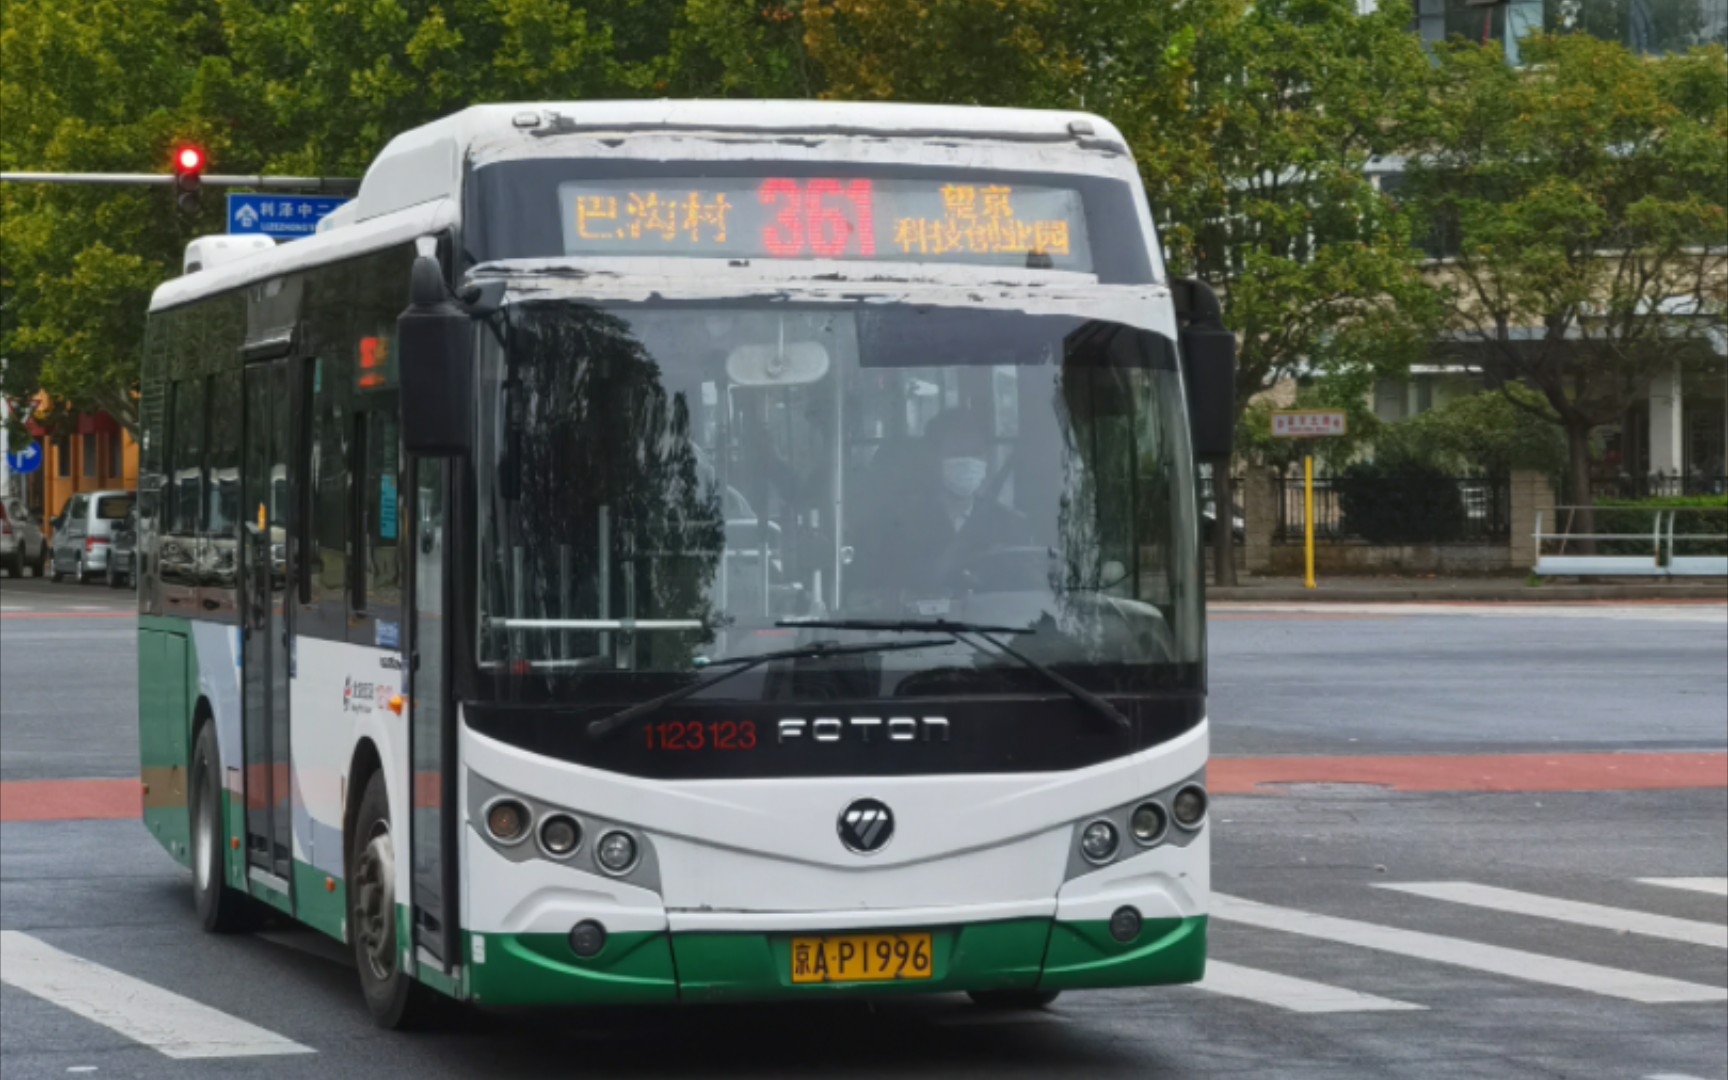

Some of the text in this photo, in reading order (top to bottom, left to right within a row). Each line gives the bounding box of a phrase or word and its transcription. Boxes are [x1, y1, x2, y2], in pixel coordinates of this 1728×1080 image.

[260, 202, 340, 218] 利泽中二
[577, 191, 732, 243] 巴沟村
[757, 178, 874, 257] 361
[940, 184, 1013, 219] 望京
[894, 217, 1070, 255] 科技创业园
[644, 721, 757, 750] 1123123
[778, 717, 949, 744] FOTON
